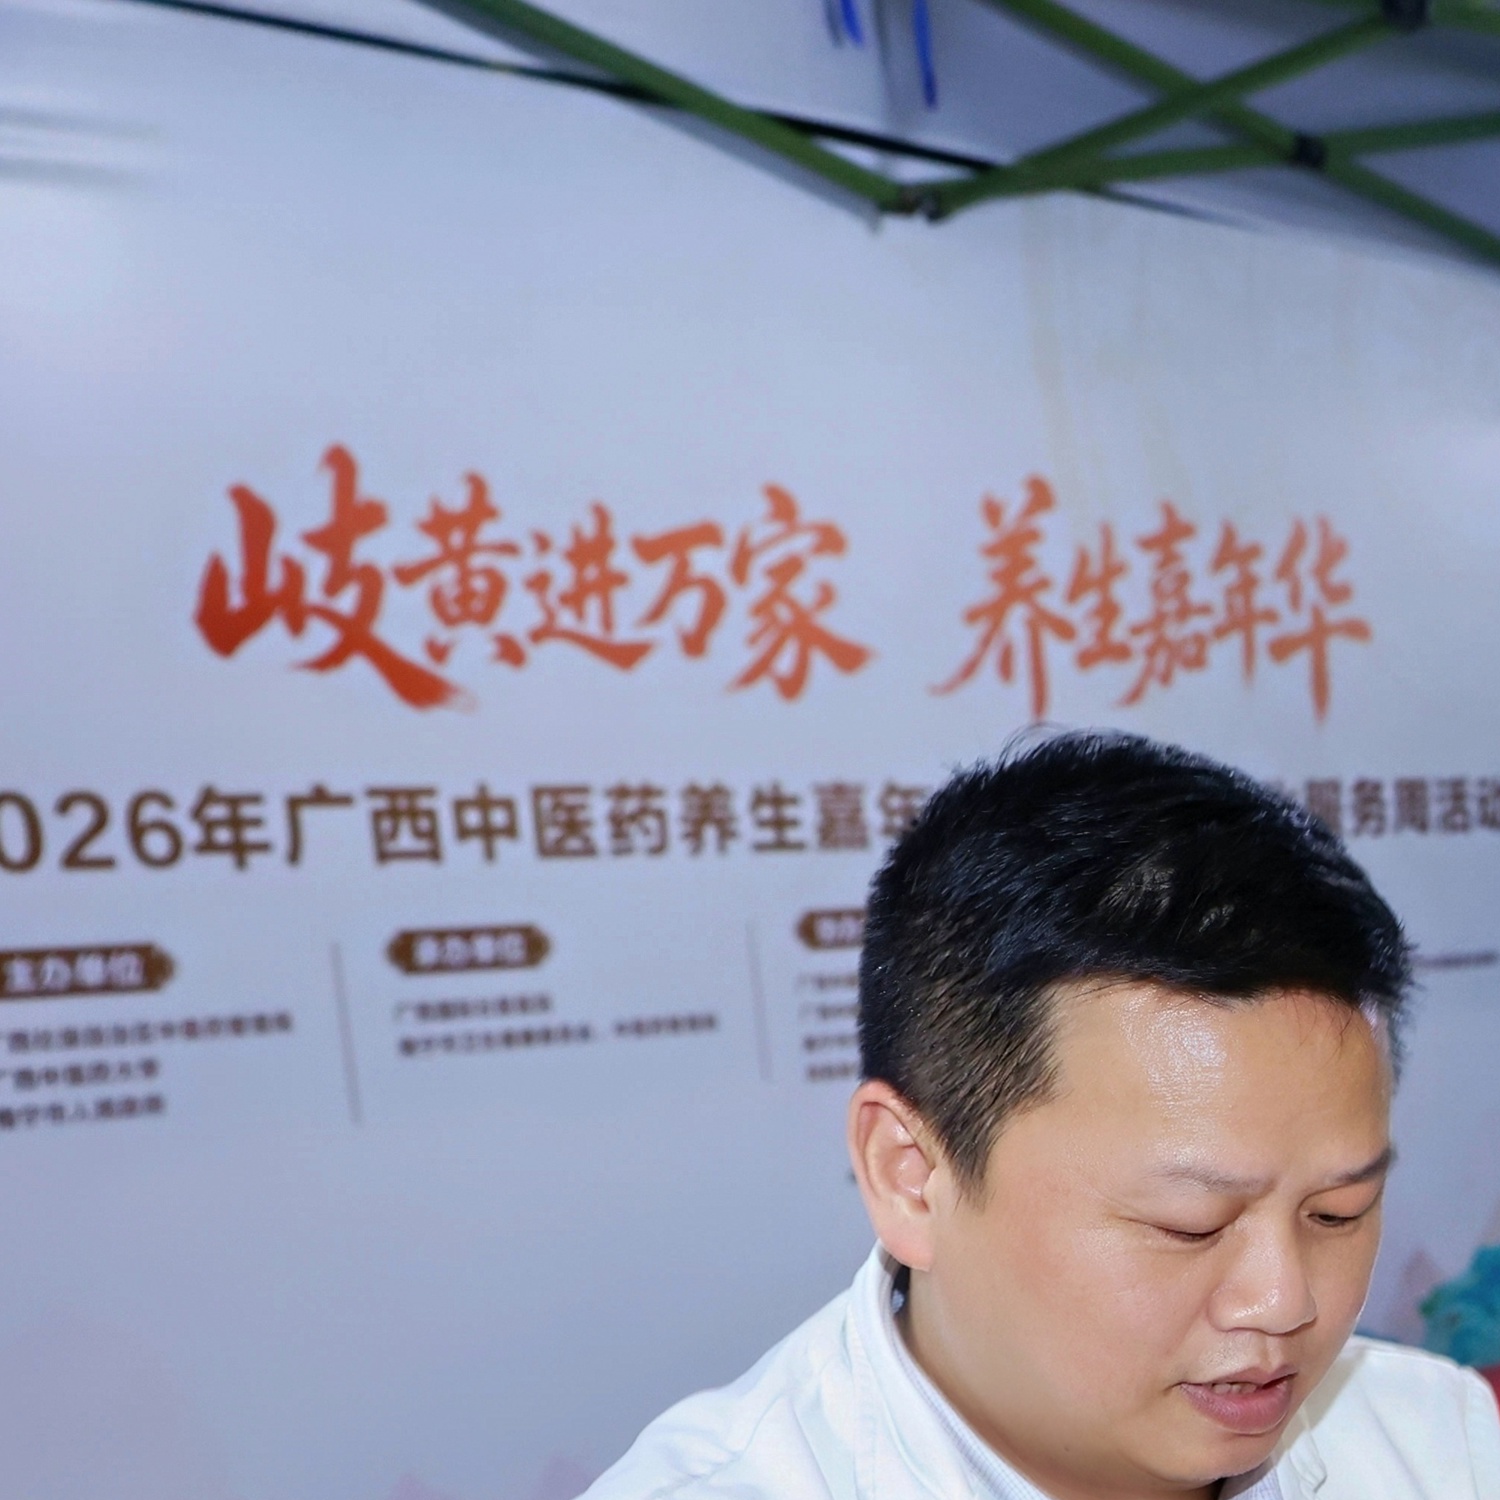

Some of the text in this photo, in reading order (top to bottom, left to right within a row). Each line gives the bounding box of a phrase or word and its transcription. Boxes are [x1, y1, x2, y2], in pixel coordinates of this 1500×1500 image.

[194, 443, 1372, 726] 岐黄进万家 养生嘉年华
